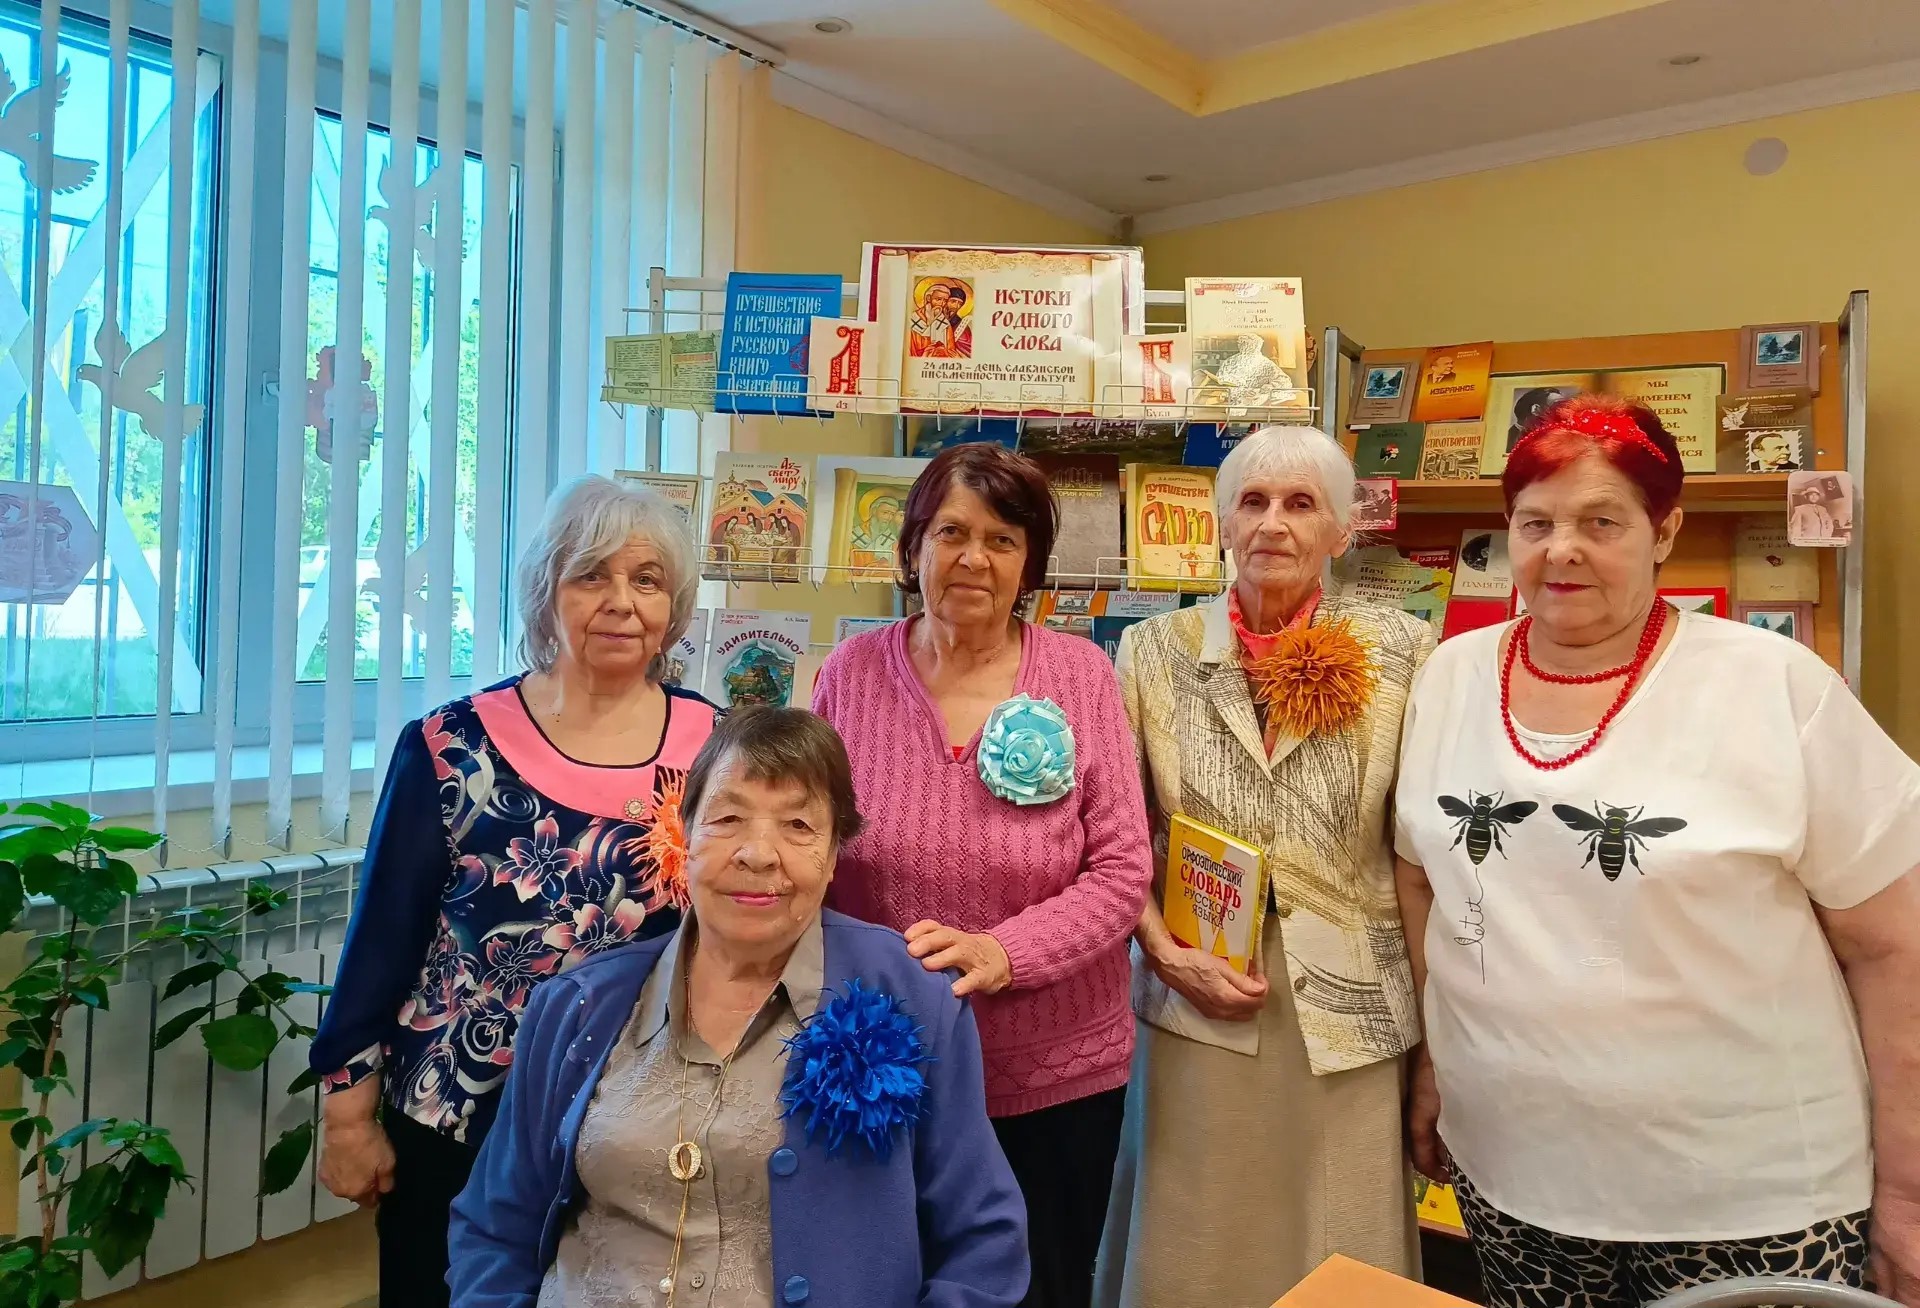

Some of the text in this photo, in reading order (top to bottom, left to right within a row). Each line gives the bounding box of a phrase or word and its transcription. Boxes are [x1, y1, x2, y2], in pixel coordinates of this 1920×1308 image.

[736, 294, 822, 314] ПУТЕШЕСТВИЕ
[994, 288, 1071, 306] ИСТОКИ
[733, 315, 804, 335] К ИСТОКАМ
[991, 310, 1073, 330] РОДНОГО
[731, 335, 790, 355] РУССКОГО
[1000, 333, 1062, 351] СЛОВА
[729, 356, 773, 376] КНИГО-
[923, 361, 936, 370] 24
[938, 362, 963, 371] МАЯ
[974, 363, 1002, 372] ДЕНЬ
[921, 370, 1076, 383] ПИСЬМЕННОСТИ И КУЛЬТУРЫ
[1430, 384, 1476, 395] ИЗБРАННОЕ
[1636, 393, 1692, 402] ИМЕНЕМ
[1146, 408, 1170, 417] Буки
[1425, 436, 1481, 449] СТИХОТВОРЕНИЯ
[768, 468, 794, 477] свет
[773, 476, 800, 491] миру
[1145, 483, 1210, 498] ПУТЕШЕСТВИЕ
[1141, 501, 1214, 545] СЛОВО
[1360, 566, 1384, 575] Нам
[1462, 581, 1508, 589] ПАМЯТЬ
[1181, 846, 1243, 888] ОРФОЭПИЧЕСКИЙ
[1180, 863, 1242, 909] СЛОВАРЬ
[1184, 886, 1235, 921] РУССКОГО
[1191, 904, 1225, 930] ЯЗЫКА
